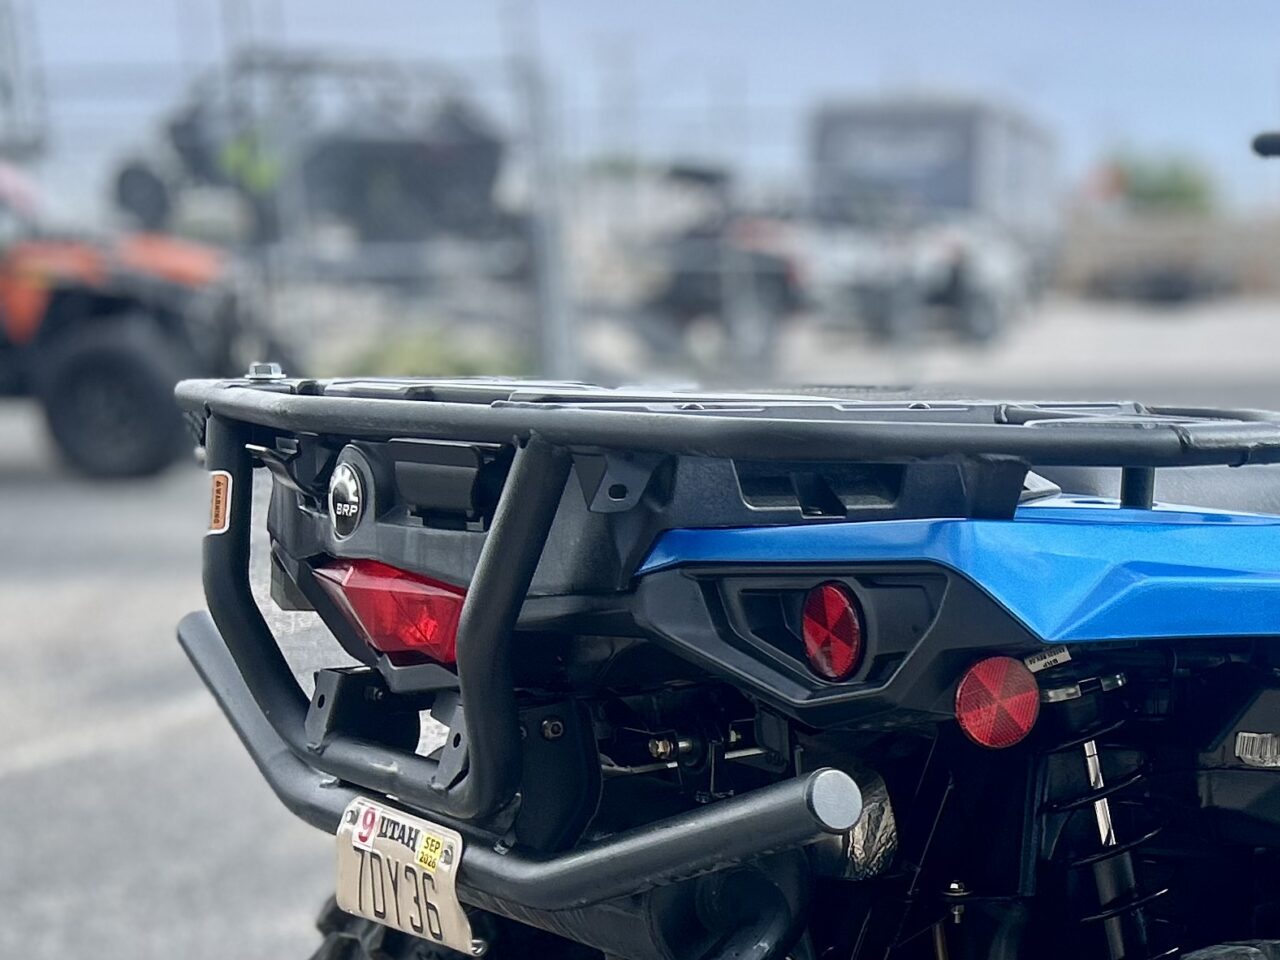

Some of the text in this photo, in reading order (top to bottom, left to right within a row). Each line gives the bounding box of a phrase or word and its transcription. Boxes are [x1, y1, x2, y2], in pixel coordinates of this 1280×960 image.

[336, 502, 358, 517] BRP
[358, 807, 376, 843] 9
[377, 816, 421, 852] UTAH
[424, 836, 441, 853] SEP
[419, 853, 437, 869] 2026
